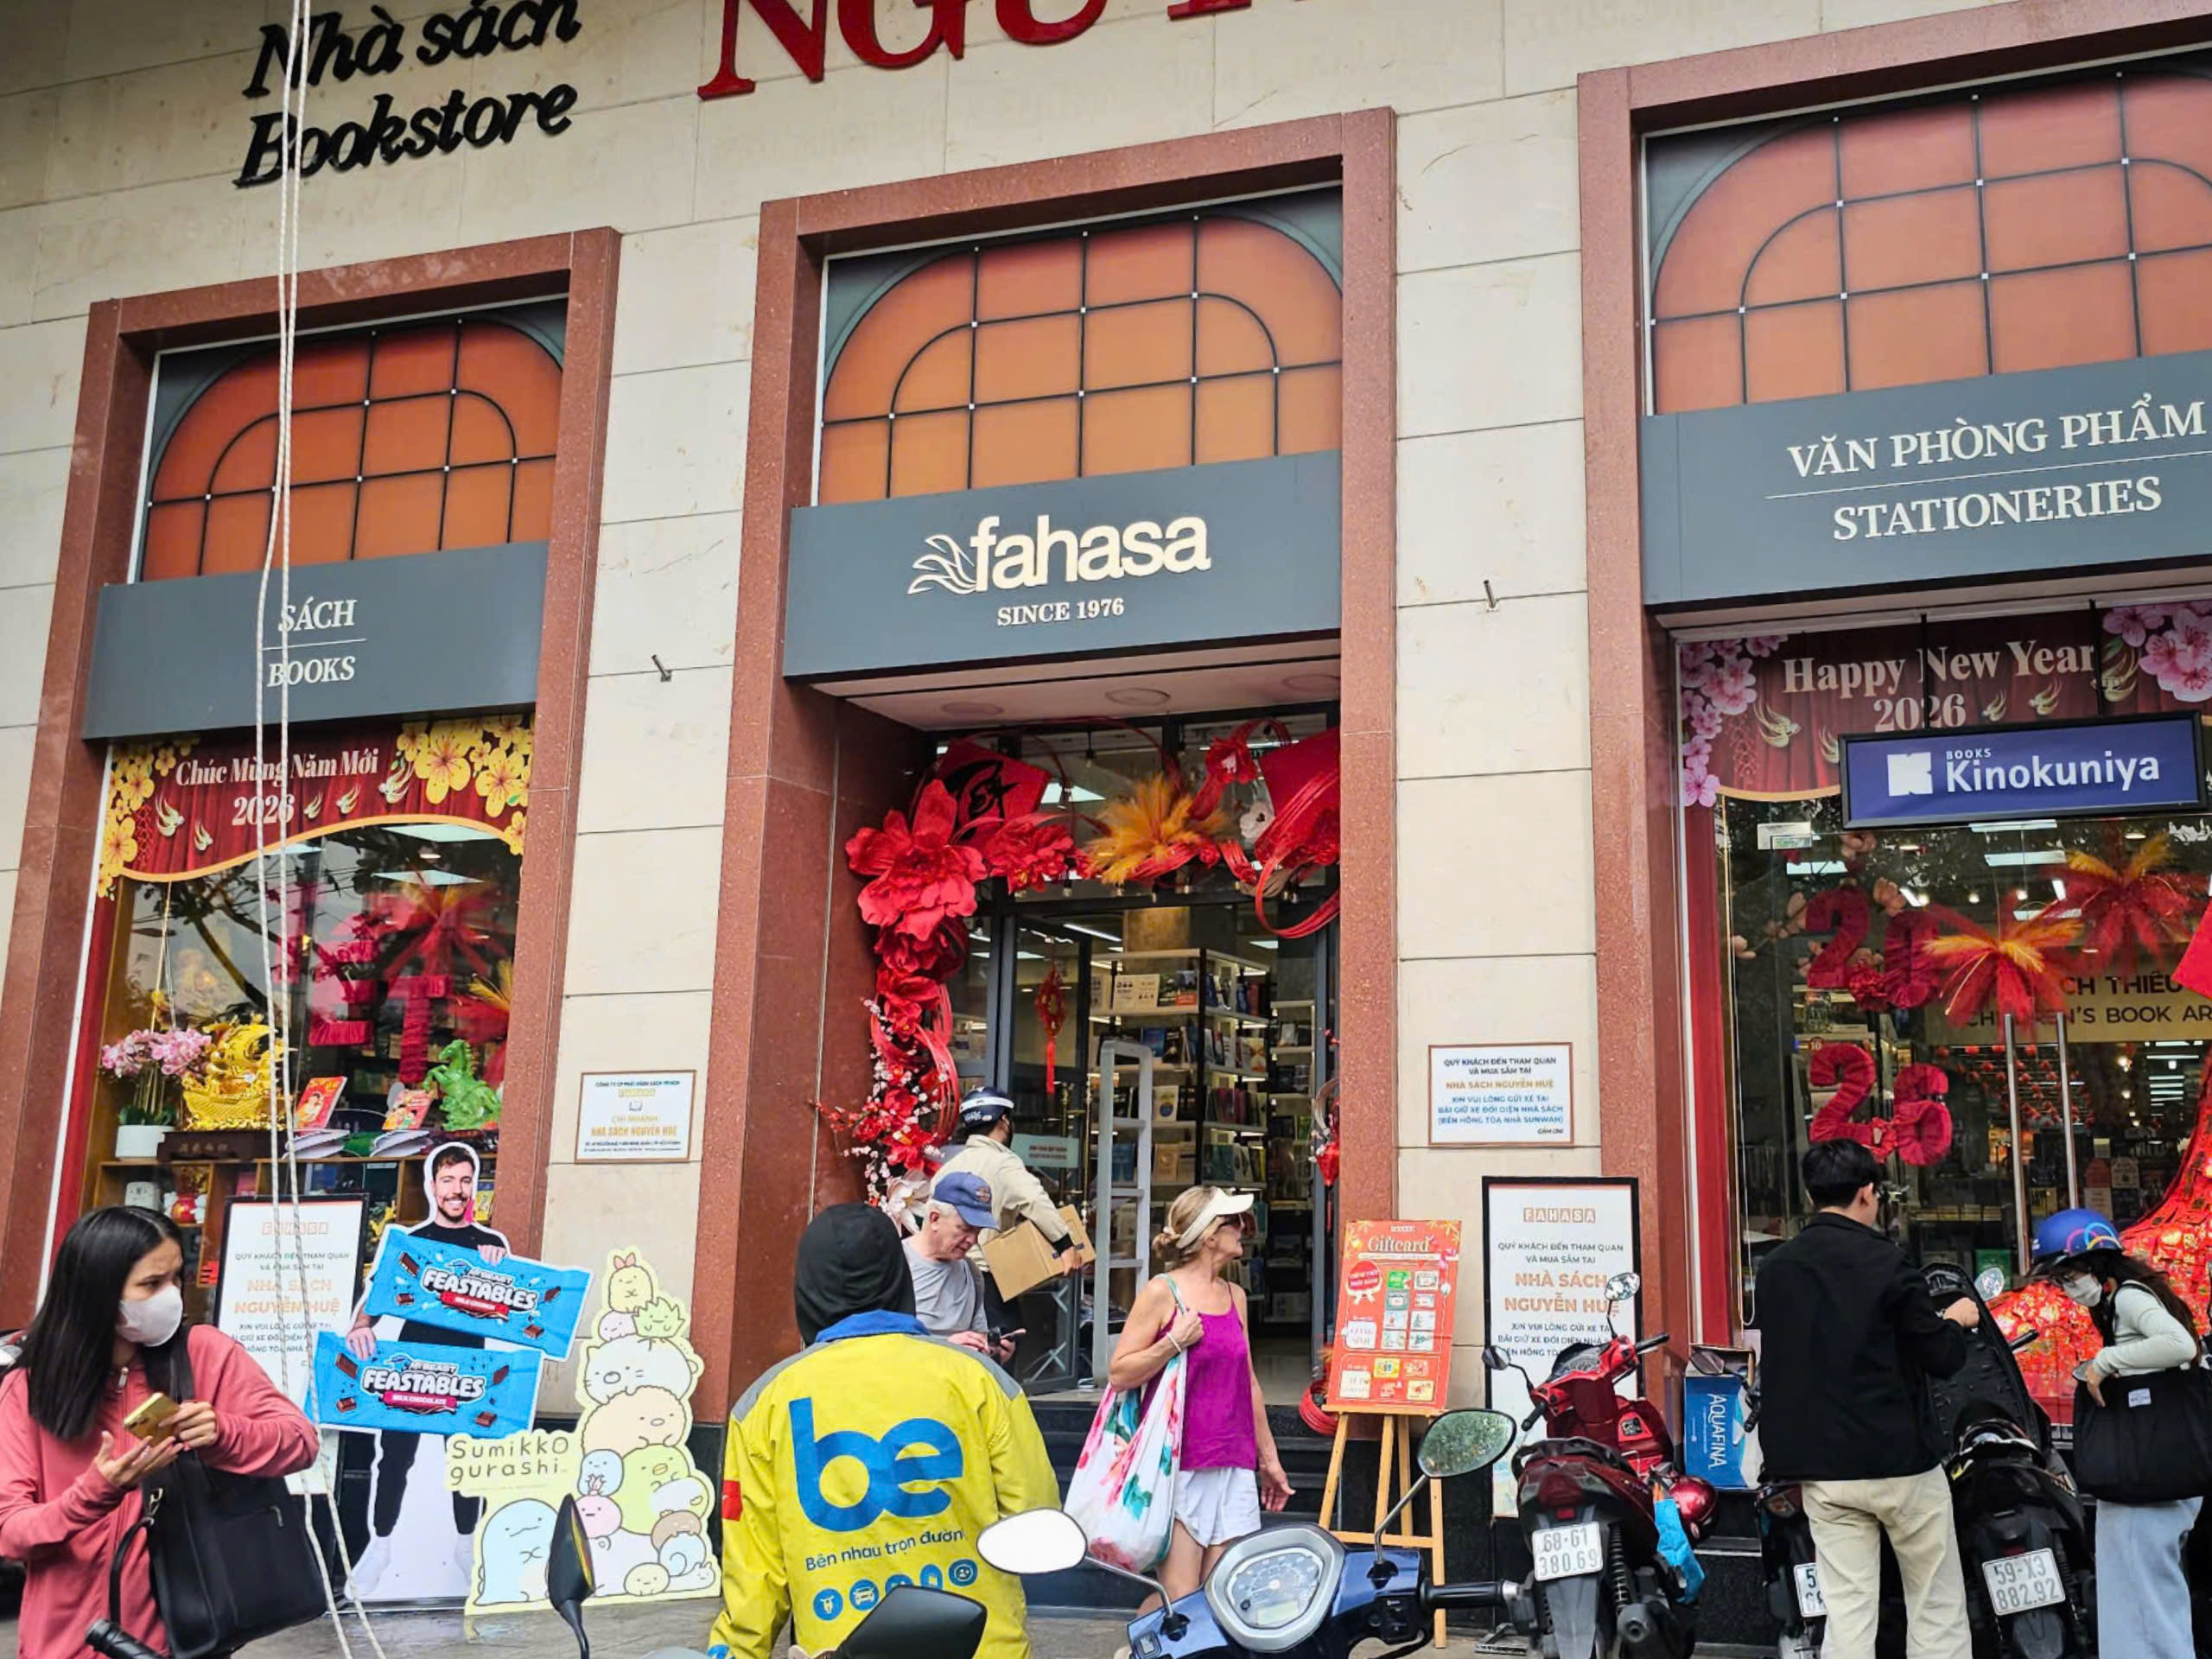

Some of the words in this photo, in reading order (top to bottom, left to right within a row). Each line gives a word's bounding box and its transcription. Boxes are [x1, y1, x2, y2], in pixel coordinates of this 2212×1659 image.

[242, 4, 406, 99] Nhà
[416, 0, 582, 65] sách
[232, 83, 579, 188] Bookstore
[1788, 434, 1878, 478] VĂN
[1890, 417, 2049, 469] PHÒNG
[2060, 392, 2207, 450] PHẨM
[1833, 476, 2163, 541] STATIONERIES
[969, 514, 1211, 593] fahasa
[278, 595, 359, 632] SÁCH
[996, 601, 1071, 626] SINCE
[1076, 598, 1125, 620] 1976
[266, 656, 356, 687] BOOKS
[1783, 658, 1907, 700] Happy
[1918, 646, 2000, 684] New
[2006, 640, 2095, 678] Year
[1873, 693, 1967, 733] 2026
[175, 759, 227, 786] Chúc
[290, 753, 337, 779] Năm
[340, 747, 379, 776] Mới
[1945, 747, 1992, 760] BOOKS
[1946, 749, 2160, 794] Kinokuniya
[232, 793, 296, 826] 2026
[2106, 1005, 2172, 1023] BOOK
[2182, 1004, 2212, 1021] AR
[1523, 1208, 1596, 1224] FAHASA
[1368, 1235, 1430, 1252] Giftcard
[1571, 1243, 1595, 1251] THAM
[1598, 1243, 1624, 1252] QUAN
[423, 1268, 537, 1311] FEASTABLES
[1515, 1271, 1554, 1287] NHÀ
[1559, 1269, 1607, 1287] SÁCH
[1504, 1292, 1577, 1313] NGUYỄN
[363, 1369, 485, 1398] FEASTABLES
[1707, 1393, 1728, 1470] AQUAFINA
[450, 1458, 559, 1486] gurashi
[788, 1396, 963, 1533] be
[804, 1554, 837, 1572] Bên
[841, 1546, 881, 1562] nhau
[884, 1536, 916, 1554] trọn
[1539, 1548, 1598, 1577] 380.69
[1993, 1554, 2047, 1586] 59-X3
[1996, 1578, 2061, 1611] 882.92
